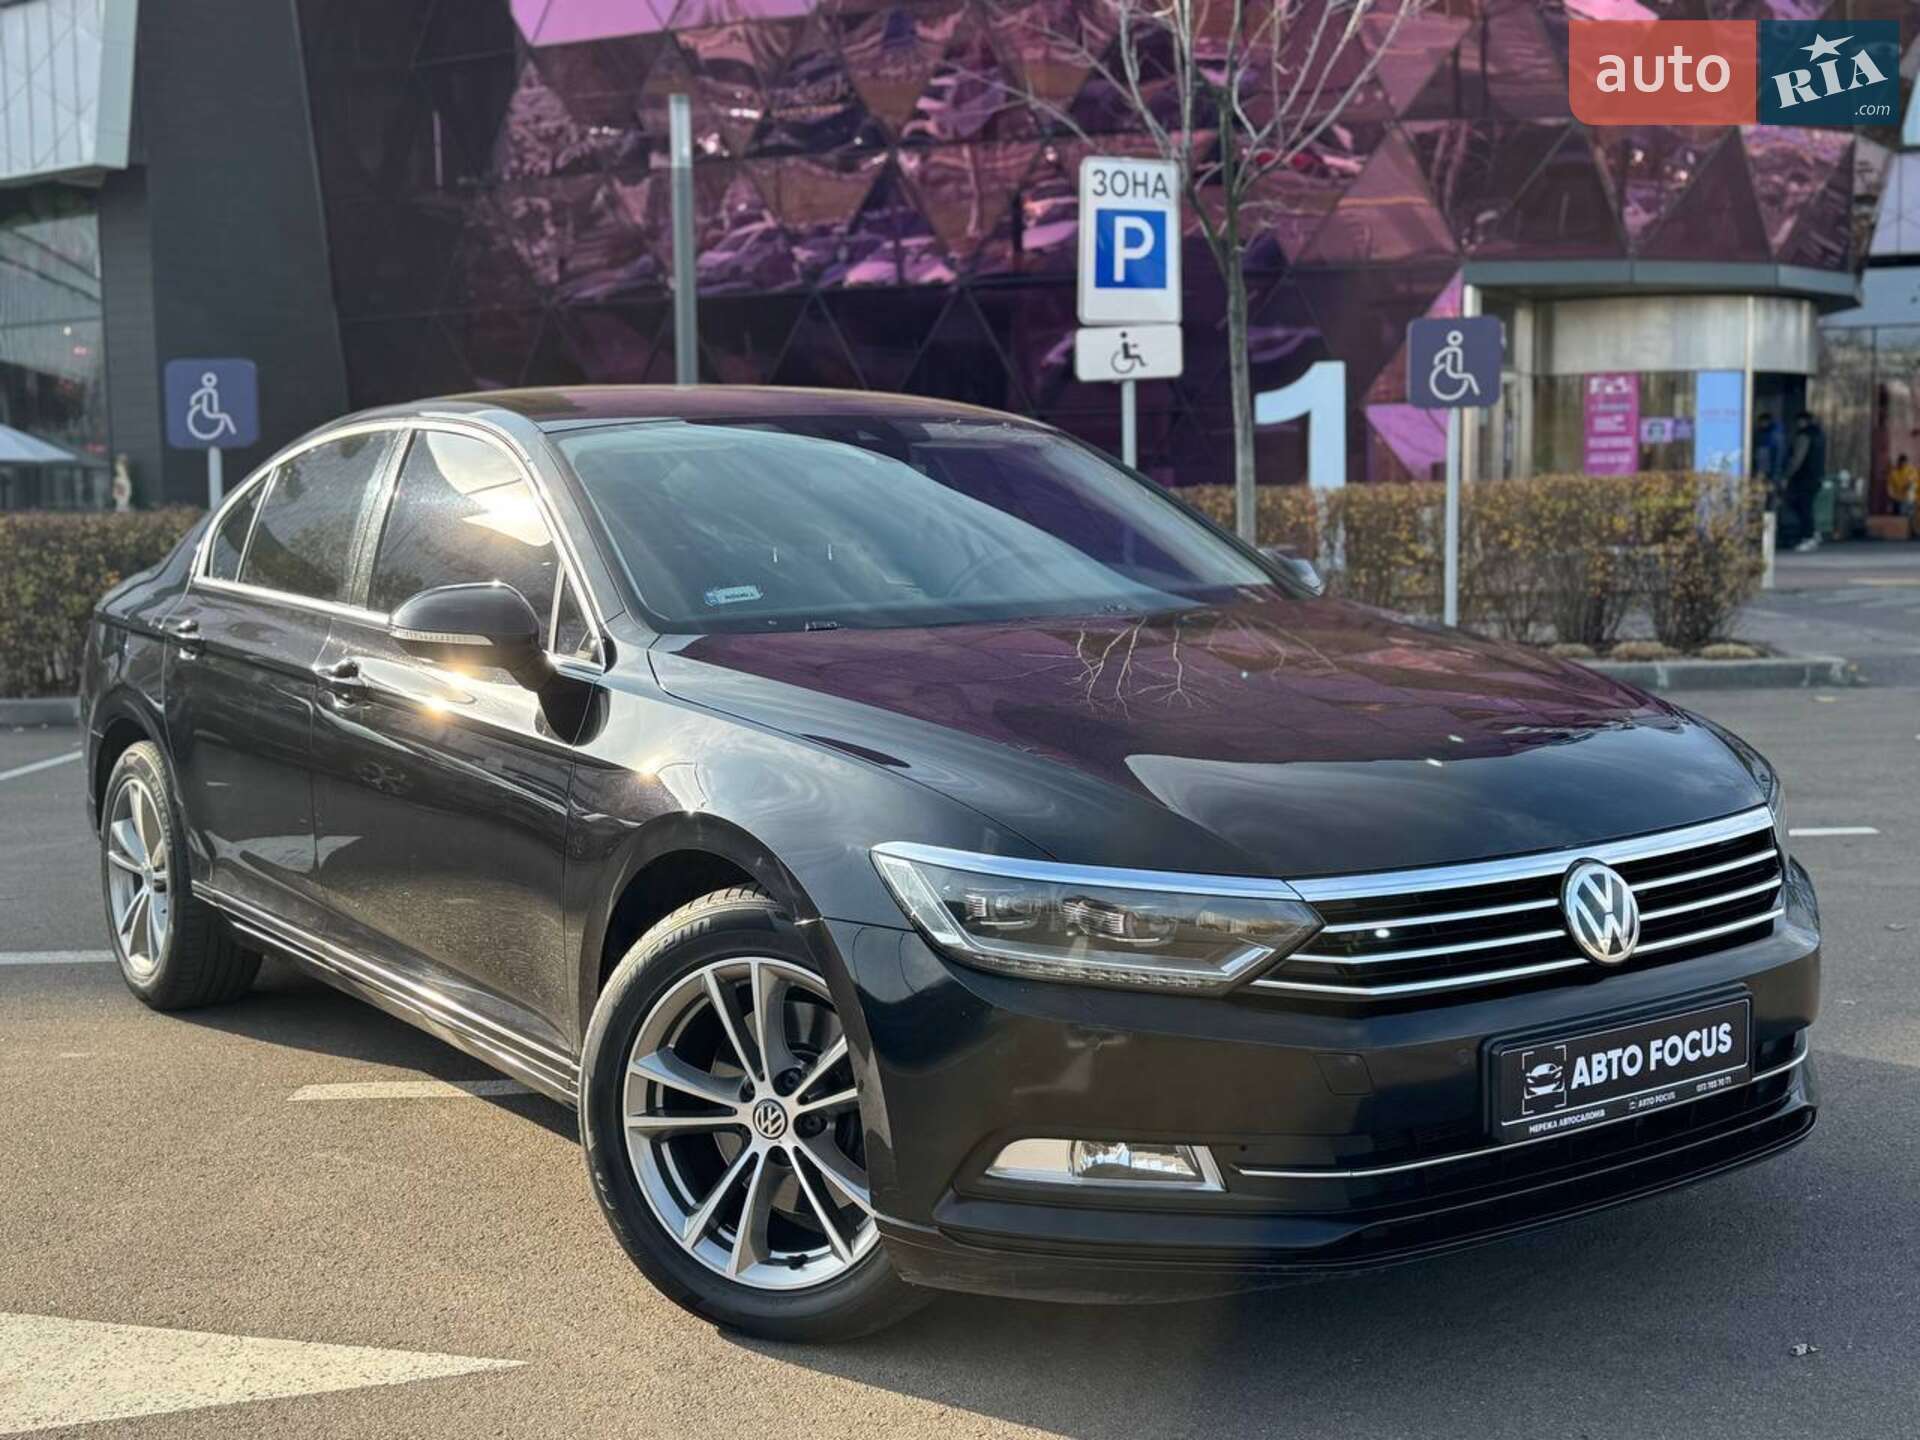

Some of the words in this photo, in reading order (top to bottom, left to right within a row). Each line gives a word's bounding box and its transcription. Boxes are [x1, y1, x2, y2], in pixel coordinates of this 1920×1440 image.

[1092, 169, 1170, 199] ЗОНА
[1114, 216, 1155, 283] P
[1254, 361, 1346, 490] 1
[1571, 1044, 1644, 1090] АВТО
[1649, 1022, 1733, 1071] FOCUS
